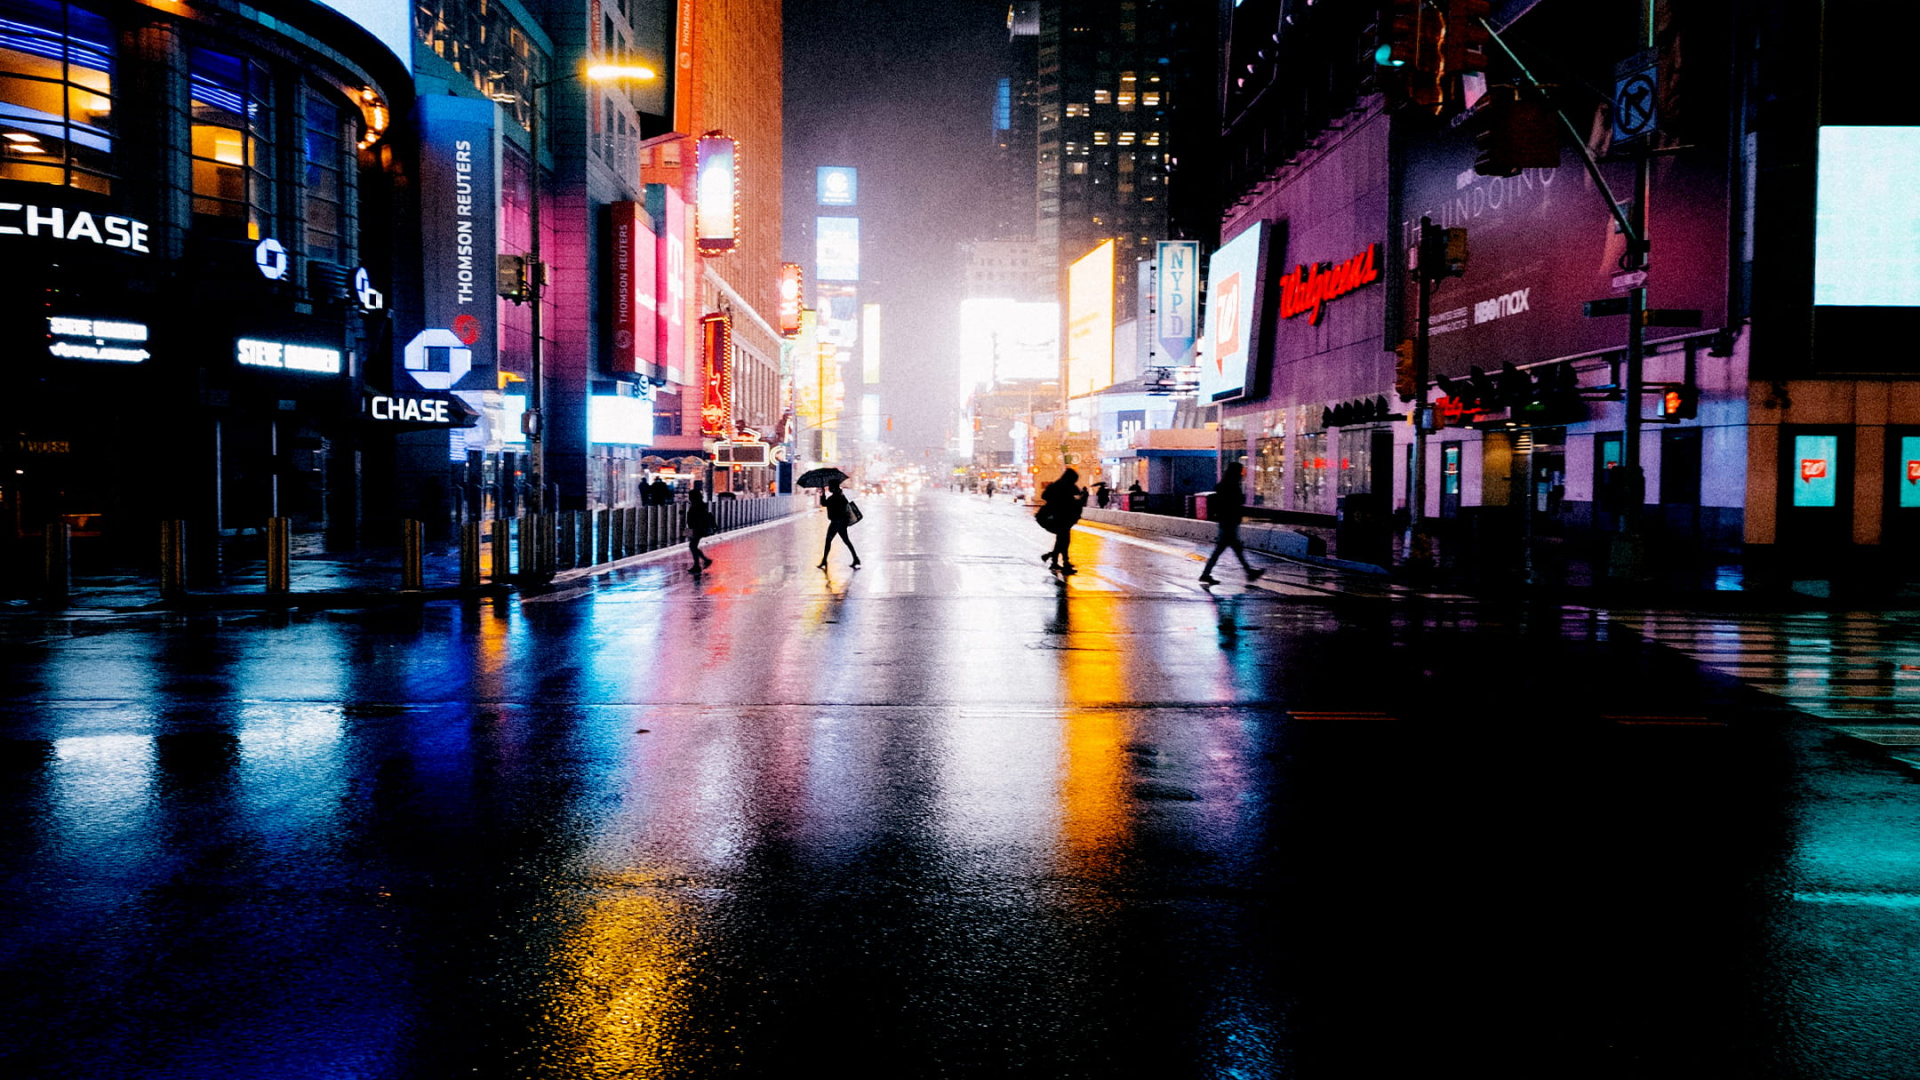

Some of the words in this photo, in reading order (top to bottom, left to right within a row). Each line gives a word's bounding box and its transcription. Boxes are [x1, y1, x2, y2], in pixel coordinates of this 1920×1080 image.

[455, 139, 472, 216] REUTERS
[0, 202, 150, 254] CHASE
[618, 224, 628, 270] REUTERS
[457, 221, 473, 305] THOMSON
[1171, 249, 1184, 336] NYPD
[1279, 243, 1377, 326] Walgreens
[618, 273, 629, 323] THOMSON
[372, 396, 450, 422] CHASE
